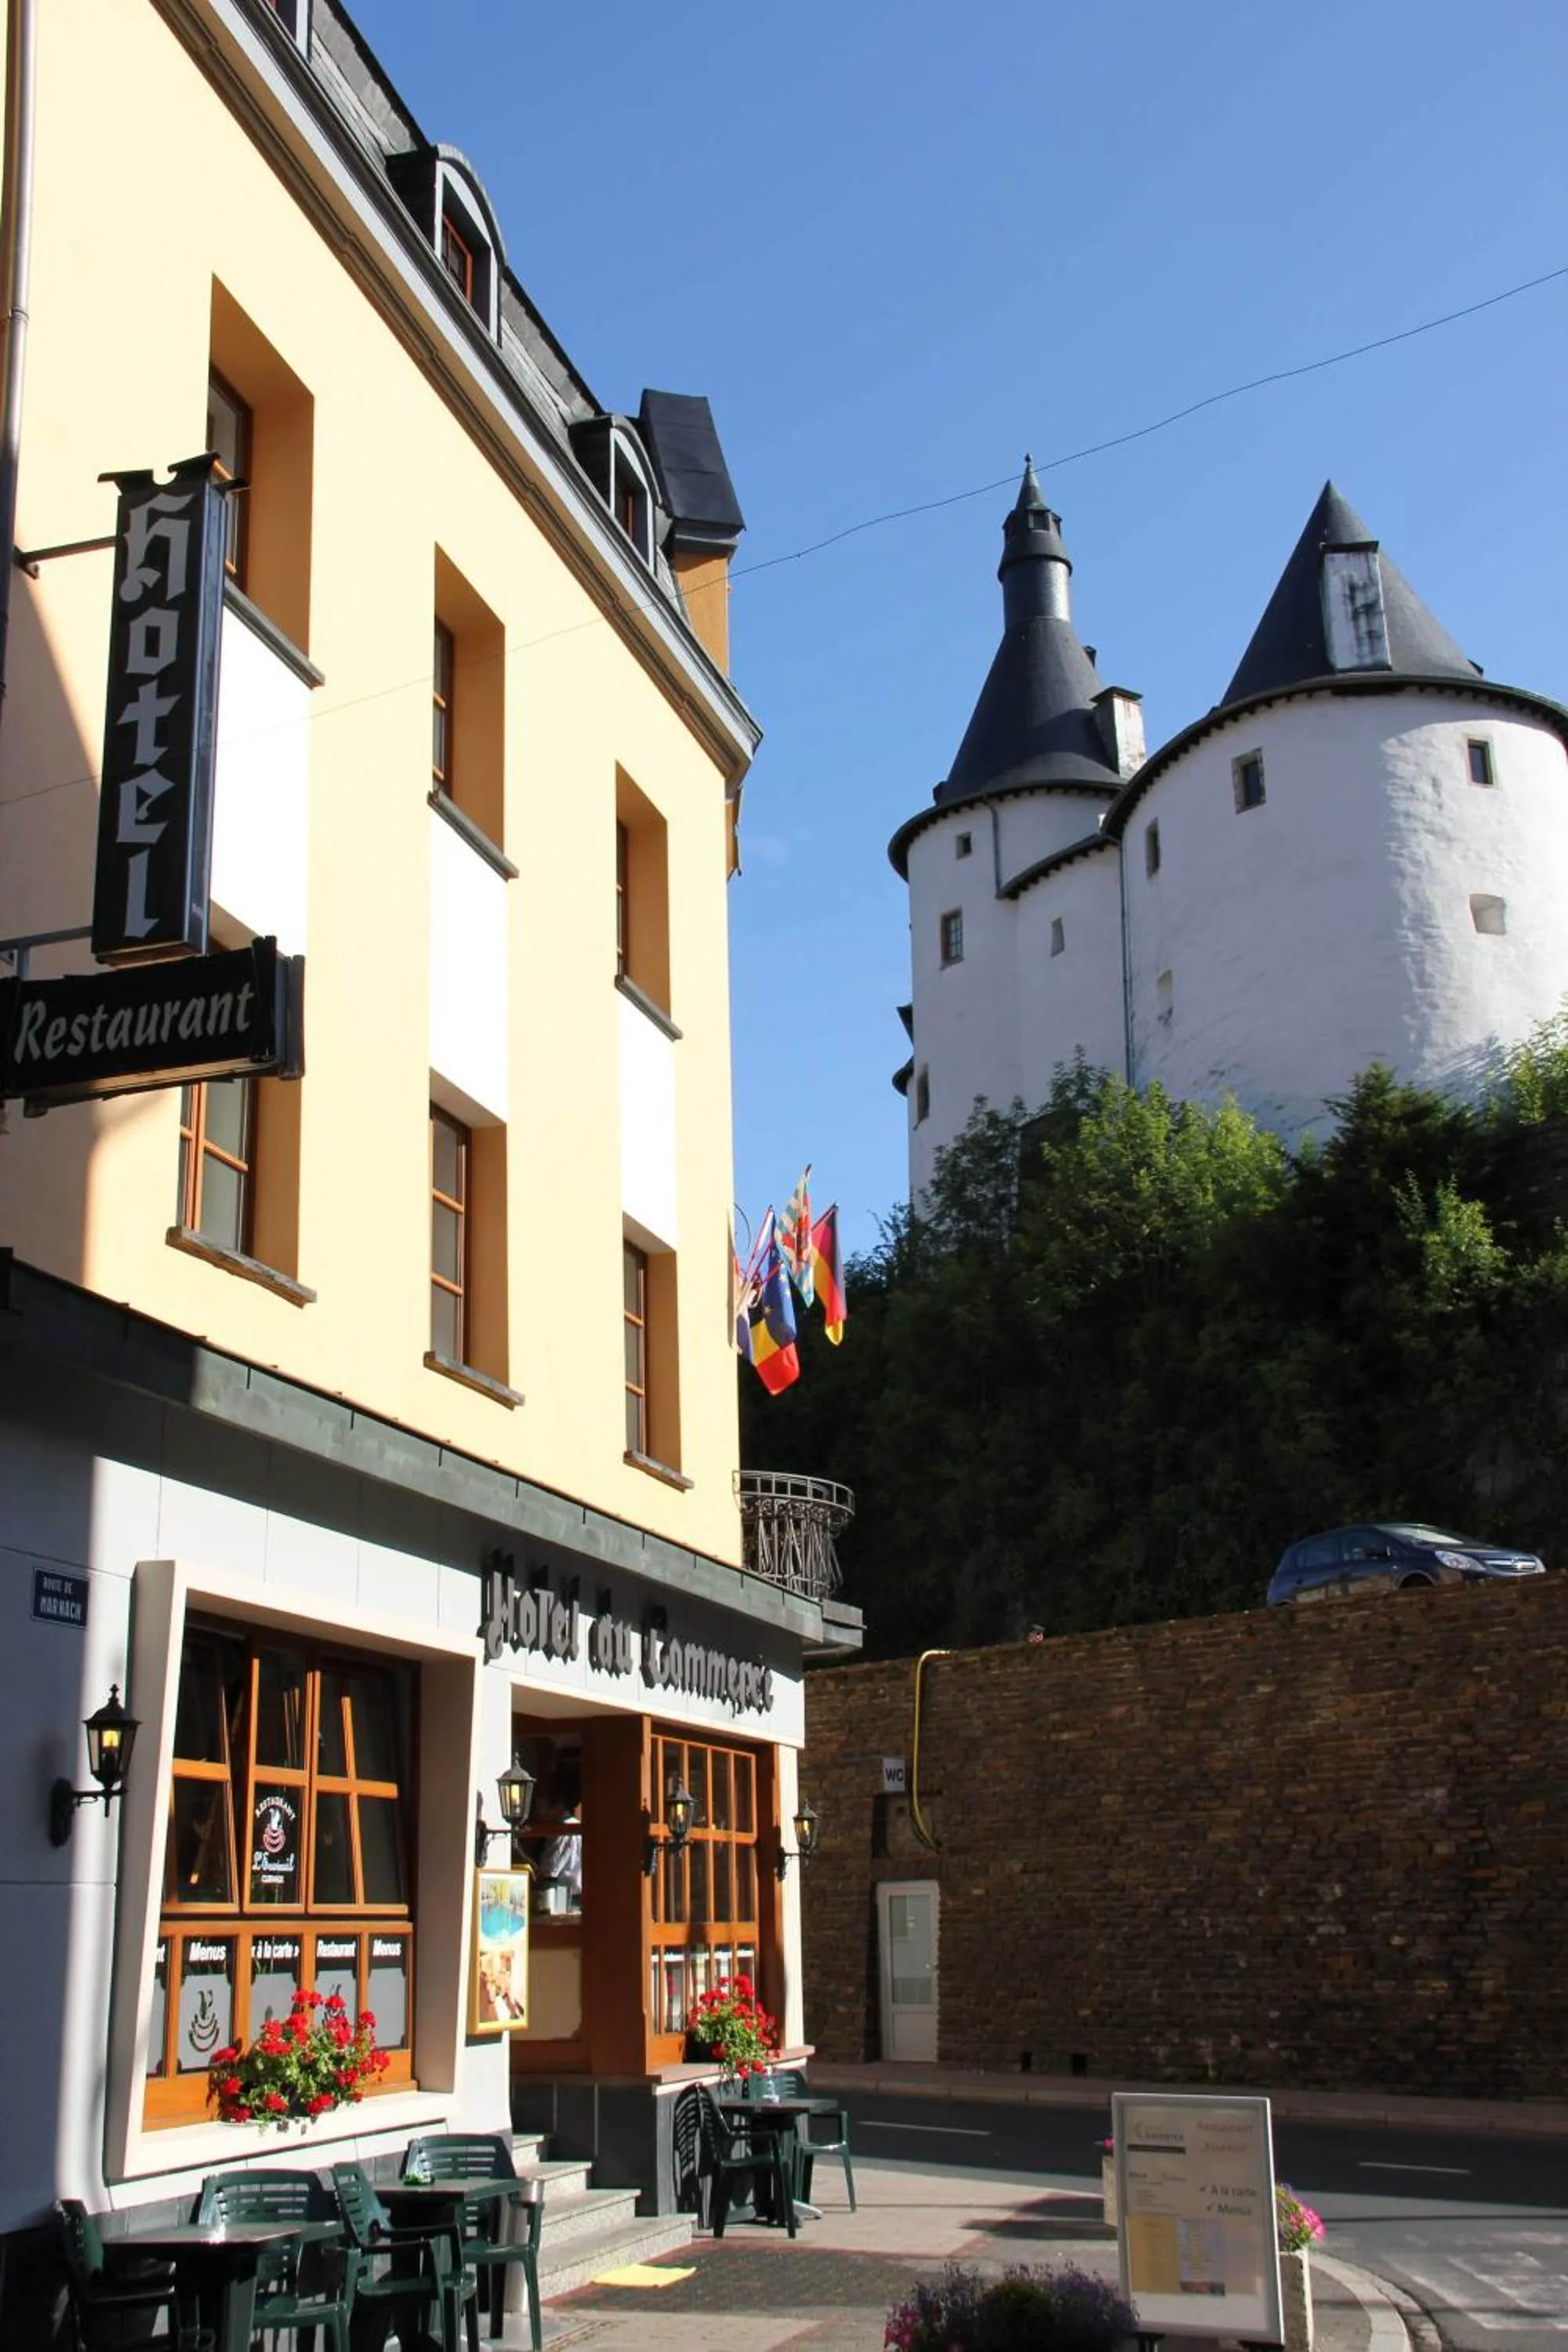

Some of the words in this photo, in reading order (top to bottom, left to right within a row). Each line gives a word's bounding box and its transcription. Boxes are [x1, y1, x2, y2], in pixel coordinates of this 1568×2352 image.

[14, 982, 255, 1065] Restaurant
[40, 1596, 82, 1621] MARNACH
[592, 1613, 633, 1676] du
[643, 1627, 775, 1715] Commerce
[885, 1768, 904, 1782] WC
[189, 1942, 227, 1962] Menus
[273, 1941, 293, 1958] carte
[316, 1938, 356, 1958] Restaurant
[372, 1938, 401, 1957] Menus
